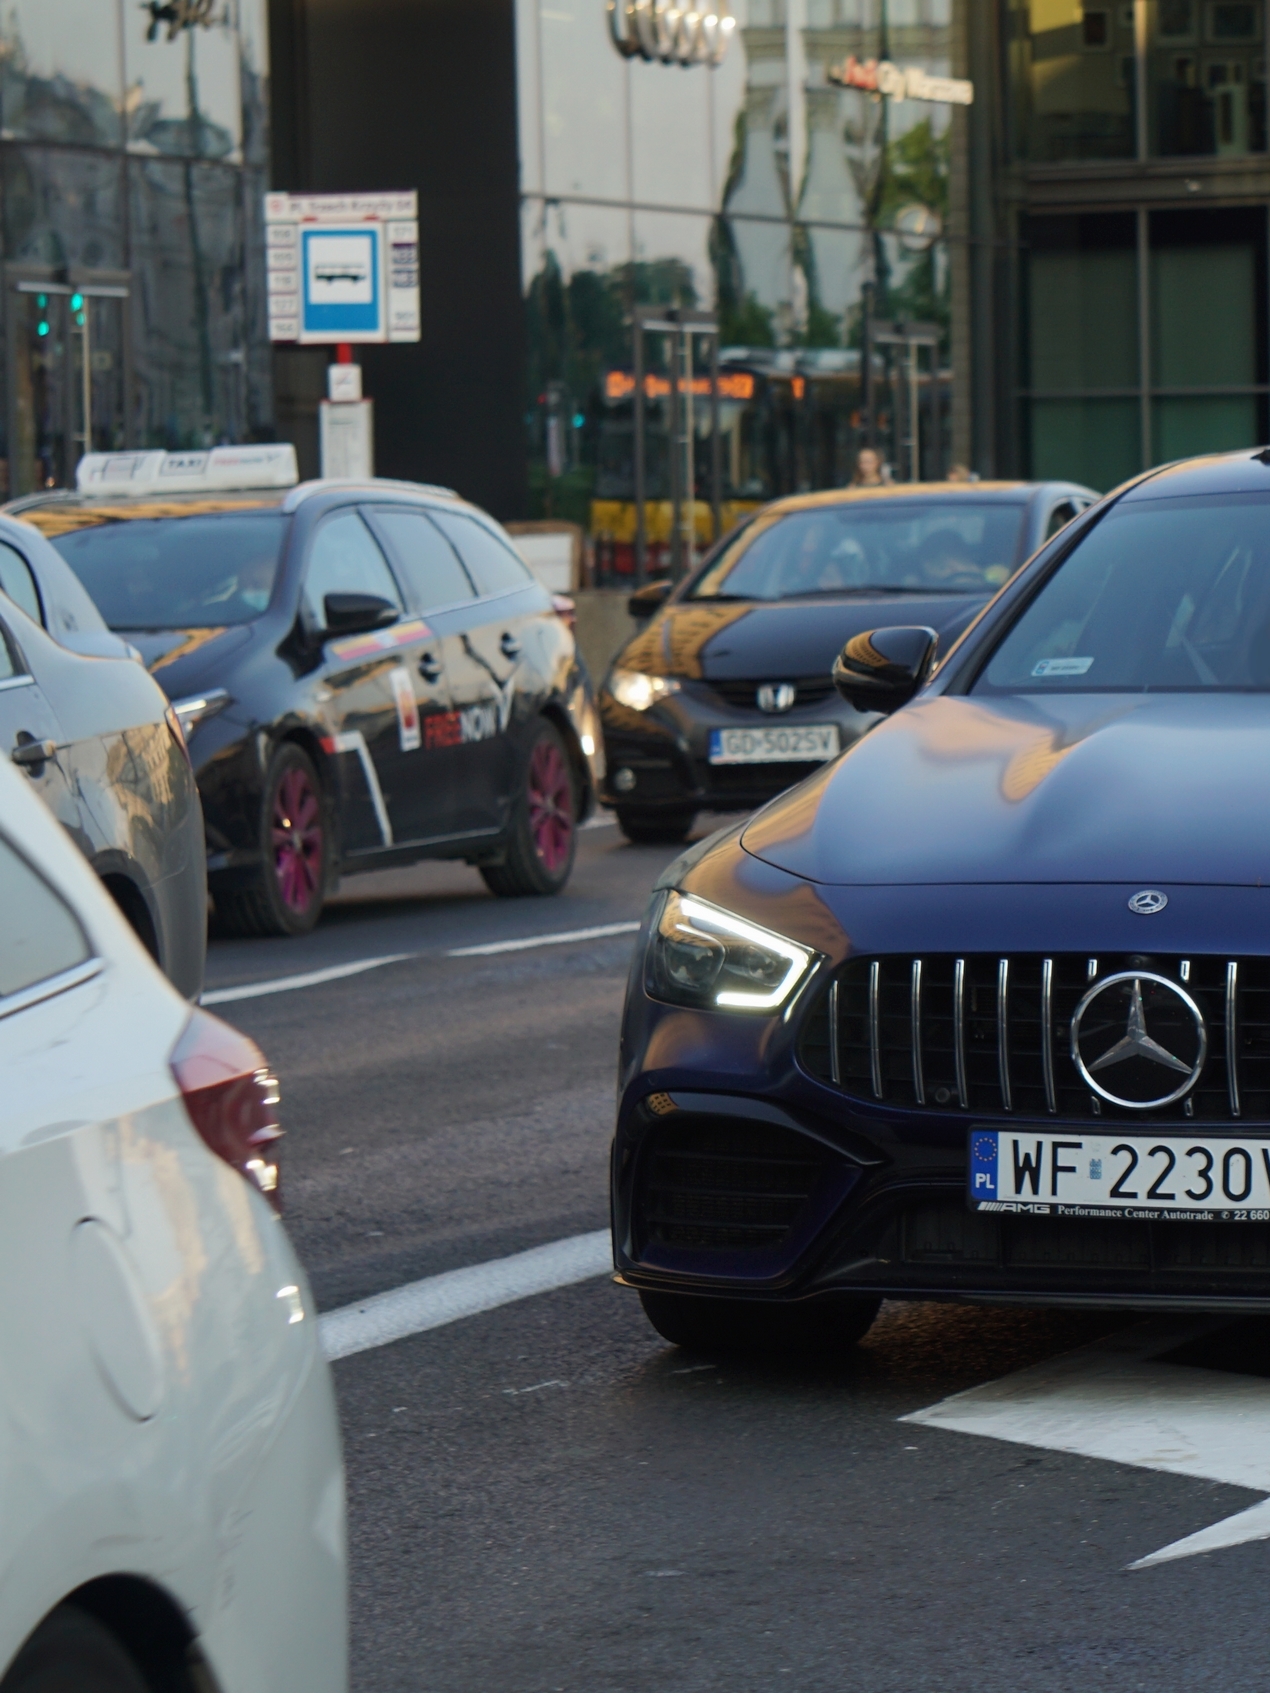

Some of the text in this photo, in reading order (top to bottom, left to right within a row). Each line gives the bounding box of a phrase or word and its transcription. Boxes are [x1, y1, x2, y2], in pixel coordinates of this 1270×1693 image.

[726, 732, 757, 755] GD
[975, 1173, 995, 1189] PL
[1012, 1139, 1083, 1196] WF
[1057, 1204, 1122, 1217] Performance
[1124, 1207, 1160, 1219] Center
[1161, 1209, 1214, 1220] Autotrade
[1234, 1210, 1248, 1220] 22
[1250, 1210, 1270, 1220] 660
